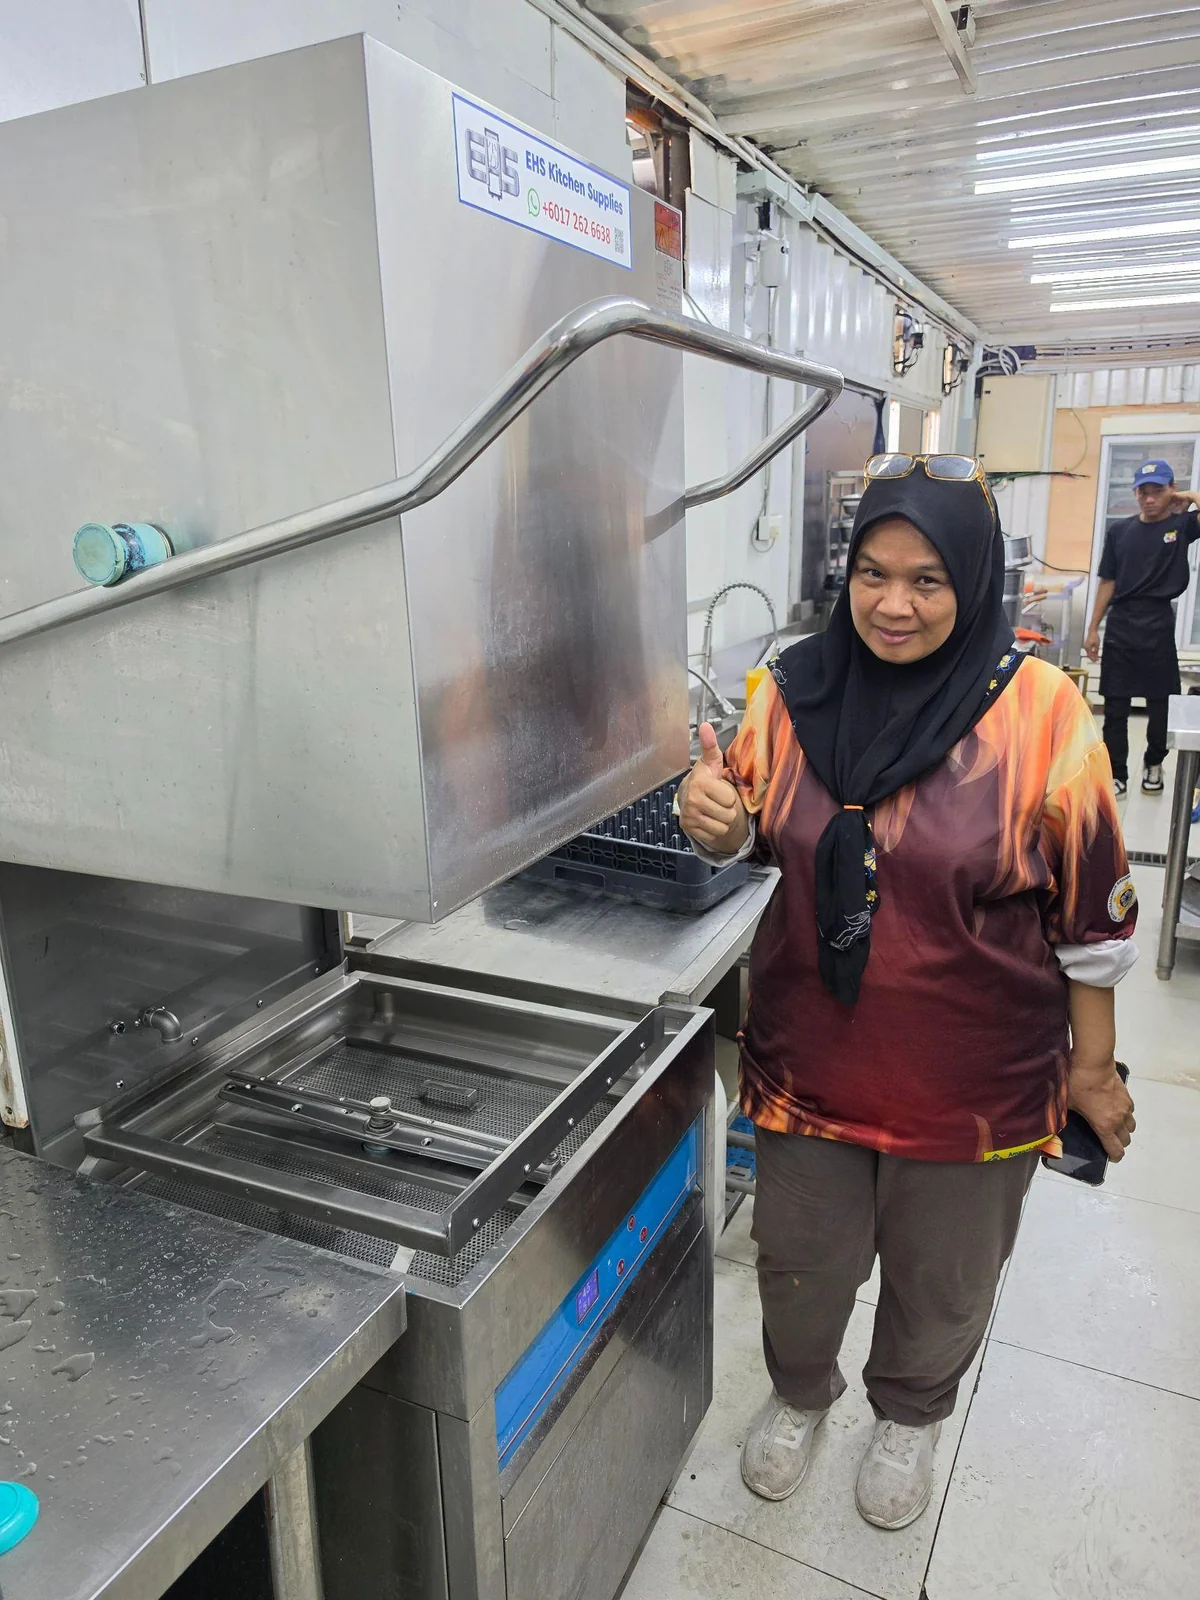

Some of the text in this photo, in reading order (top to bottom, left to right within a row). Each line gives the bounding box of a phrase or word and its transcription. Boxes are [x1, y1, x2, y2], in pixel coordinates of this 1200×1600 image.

[525, 150, 624, 216] EHS Kitchen Supplies
[542, 201, 611, 245] +6017 262 6638
